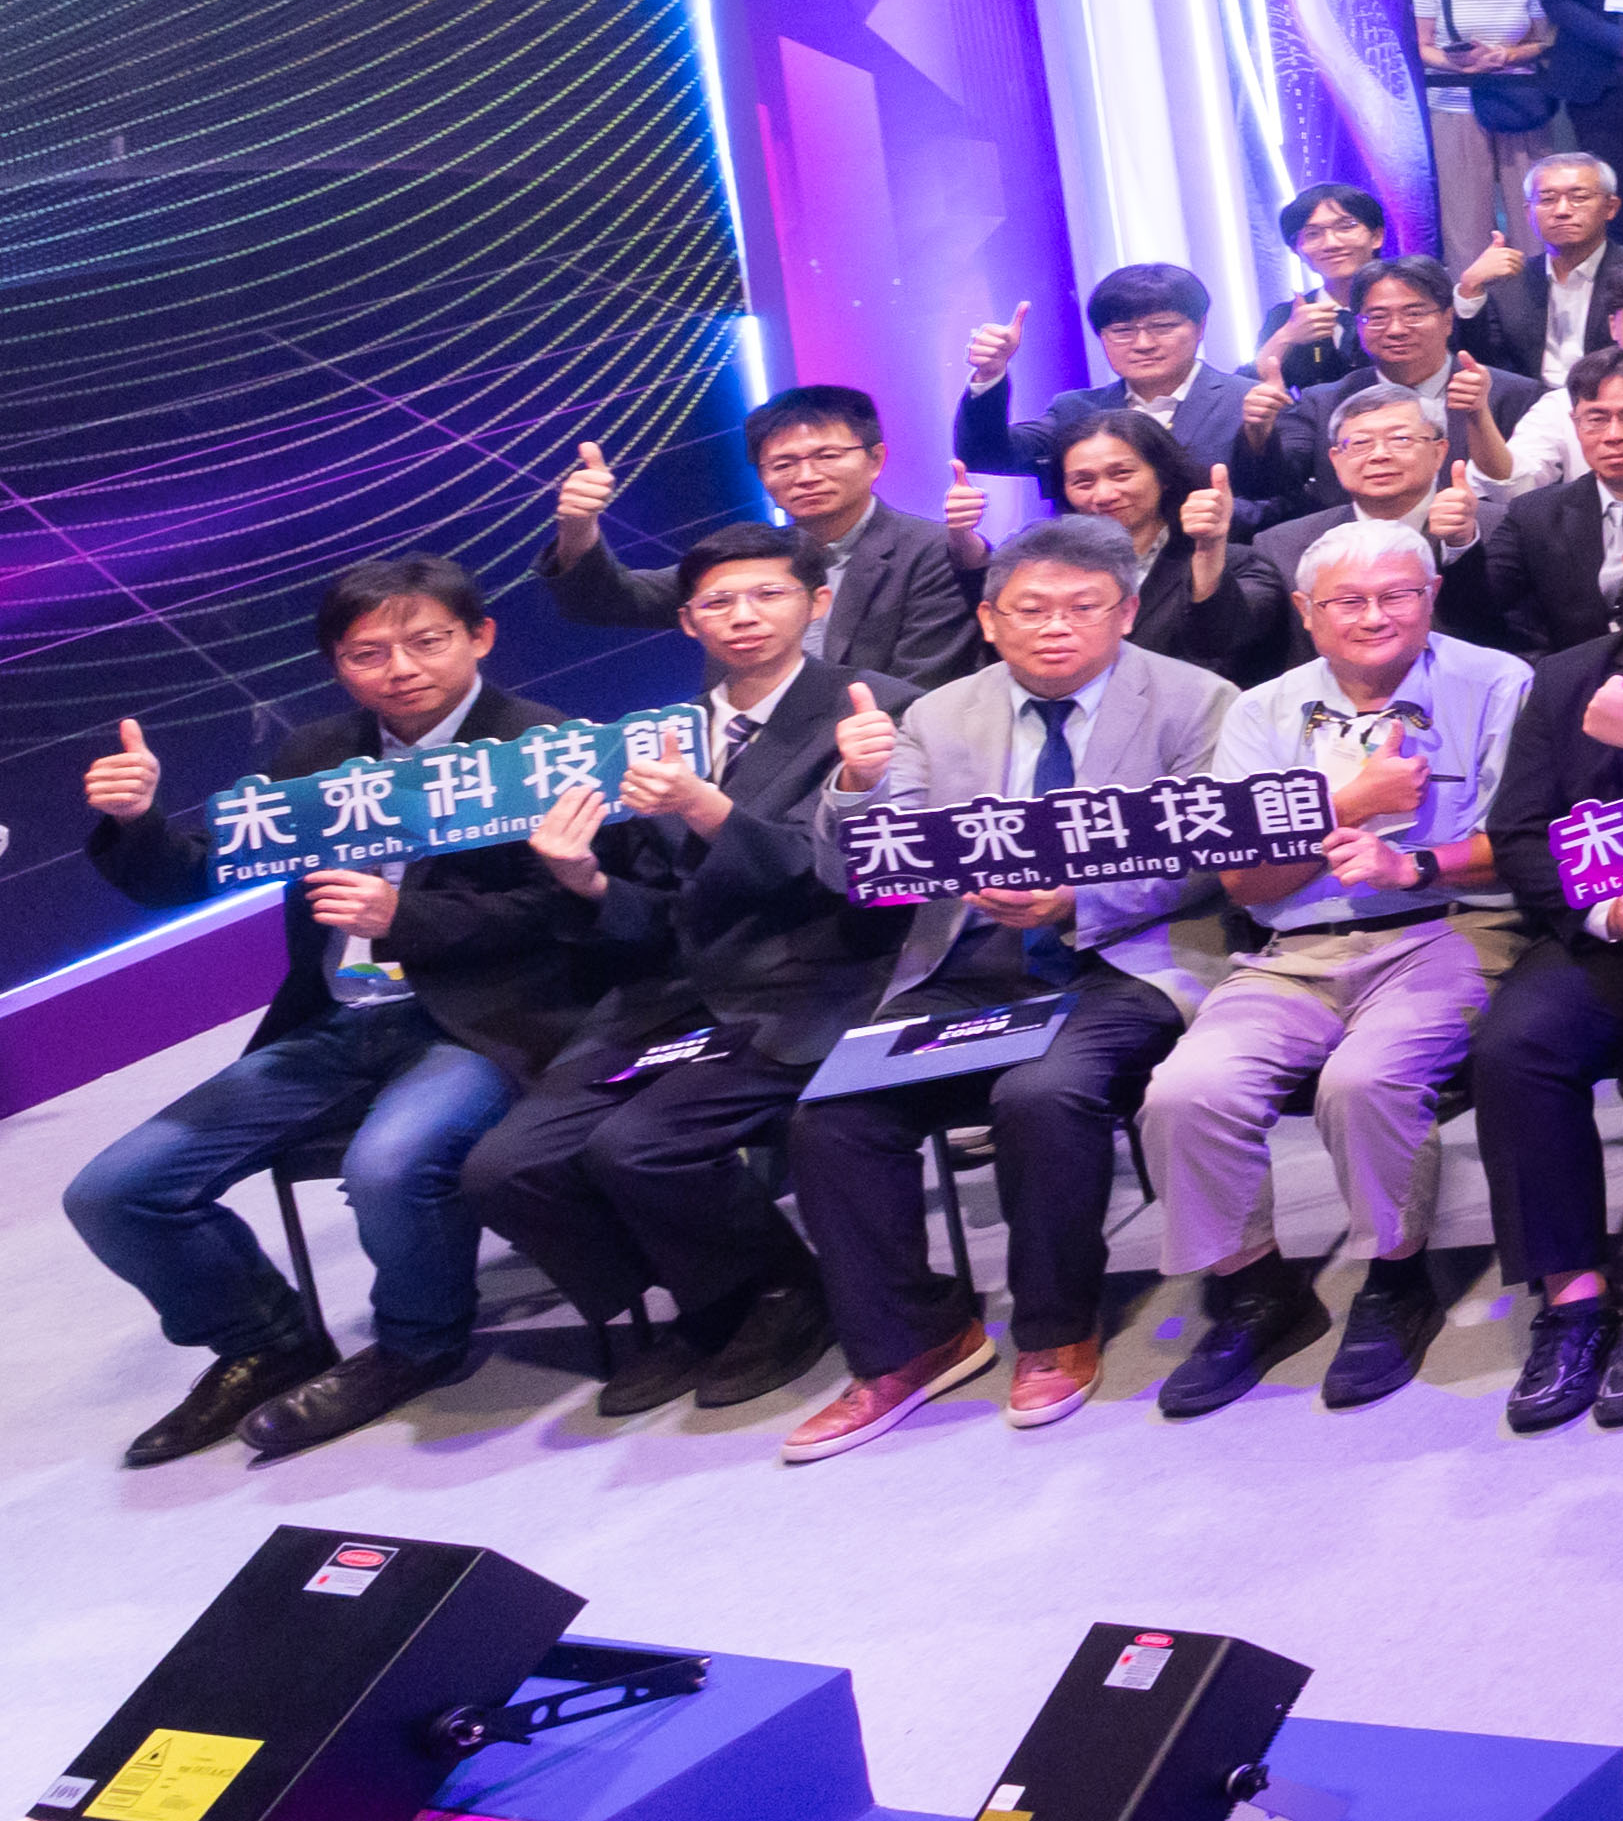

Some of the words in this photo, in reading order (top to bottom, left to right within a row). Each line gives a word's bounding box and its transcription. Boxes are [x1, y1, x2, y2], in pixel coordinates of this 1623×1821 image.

[216, 710, 701, 858] 未來科技館
[849, 772, 1329, 876] 未來科技館
[216, 849, 321, 887] Future
[332, 834, 415, 867] Tech,
[427, 810, 547, 848] Leading
[857, 873, 961, 902] Future
[970, 863, 1056, 893] Tech,
[1065, 849, 1182, 885] Leading
[1193, 841, 1263, 871] Your
